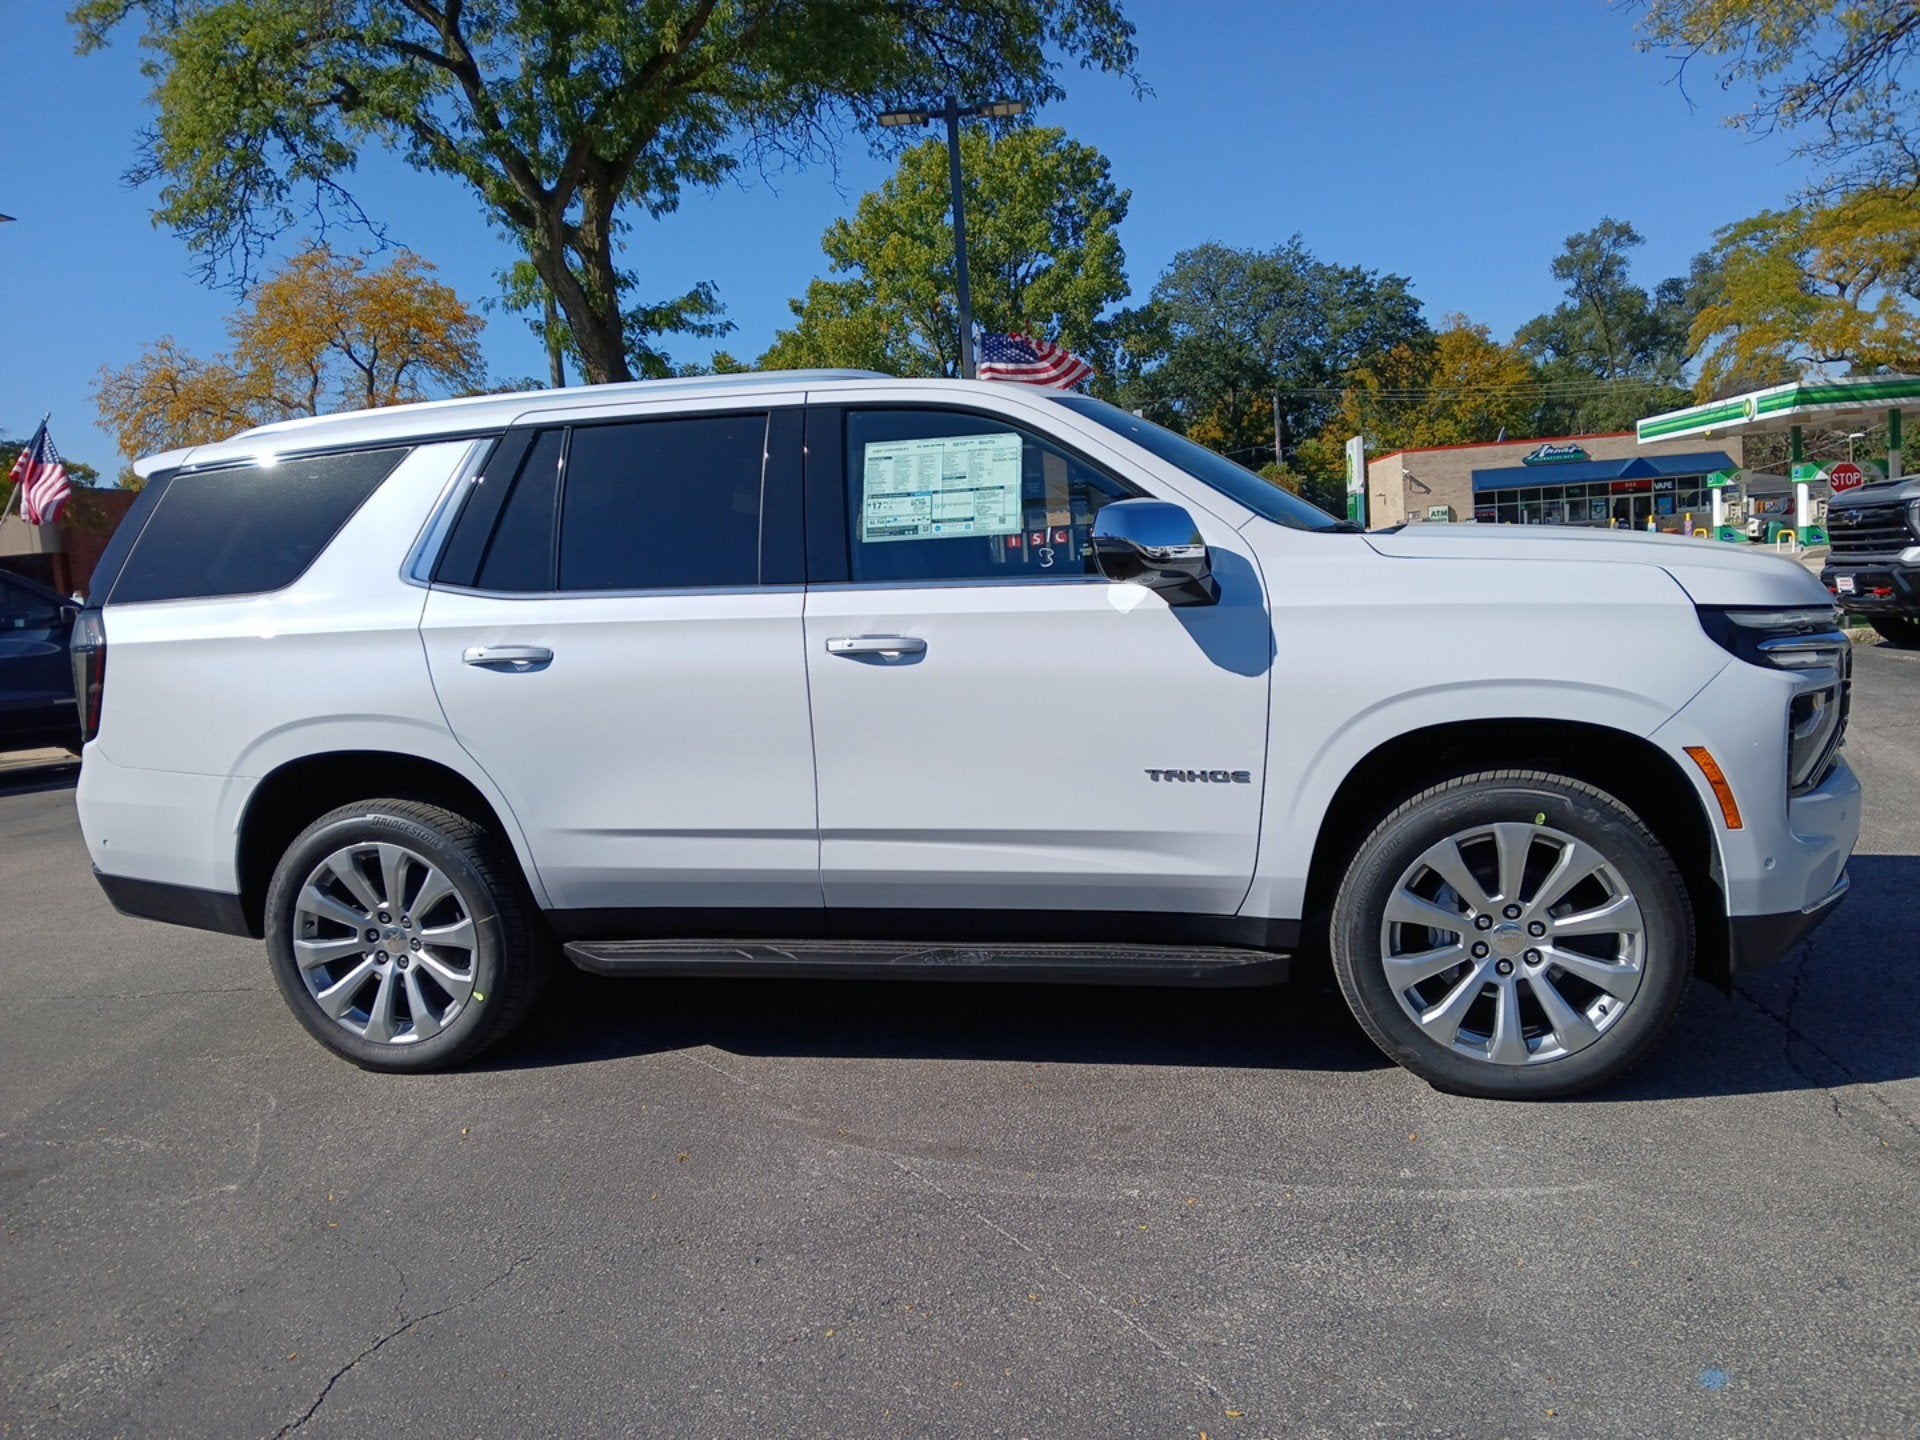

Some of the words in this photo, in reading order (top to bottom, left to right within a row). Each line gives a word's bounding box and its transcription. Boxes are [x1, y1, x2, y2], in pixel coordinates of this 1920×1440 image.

[1654, 481, 1673, 490] VAPE
[1831, 471, 1861, 486] STOP
[1431, 510, 1448, 518] ATM
[1038, 547, 1055, 568] 3
[1144, 768, 1251, 784] TAHOE
[371, 816, 441, 850] BRIDGESTONE
